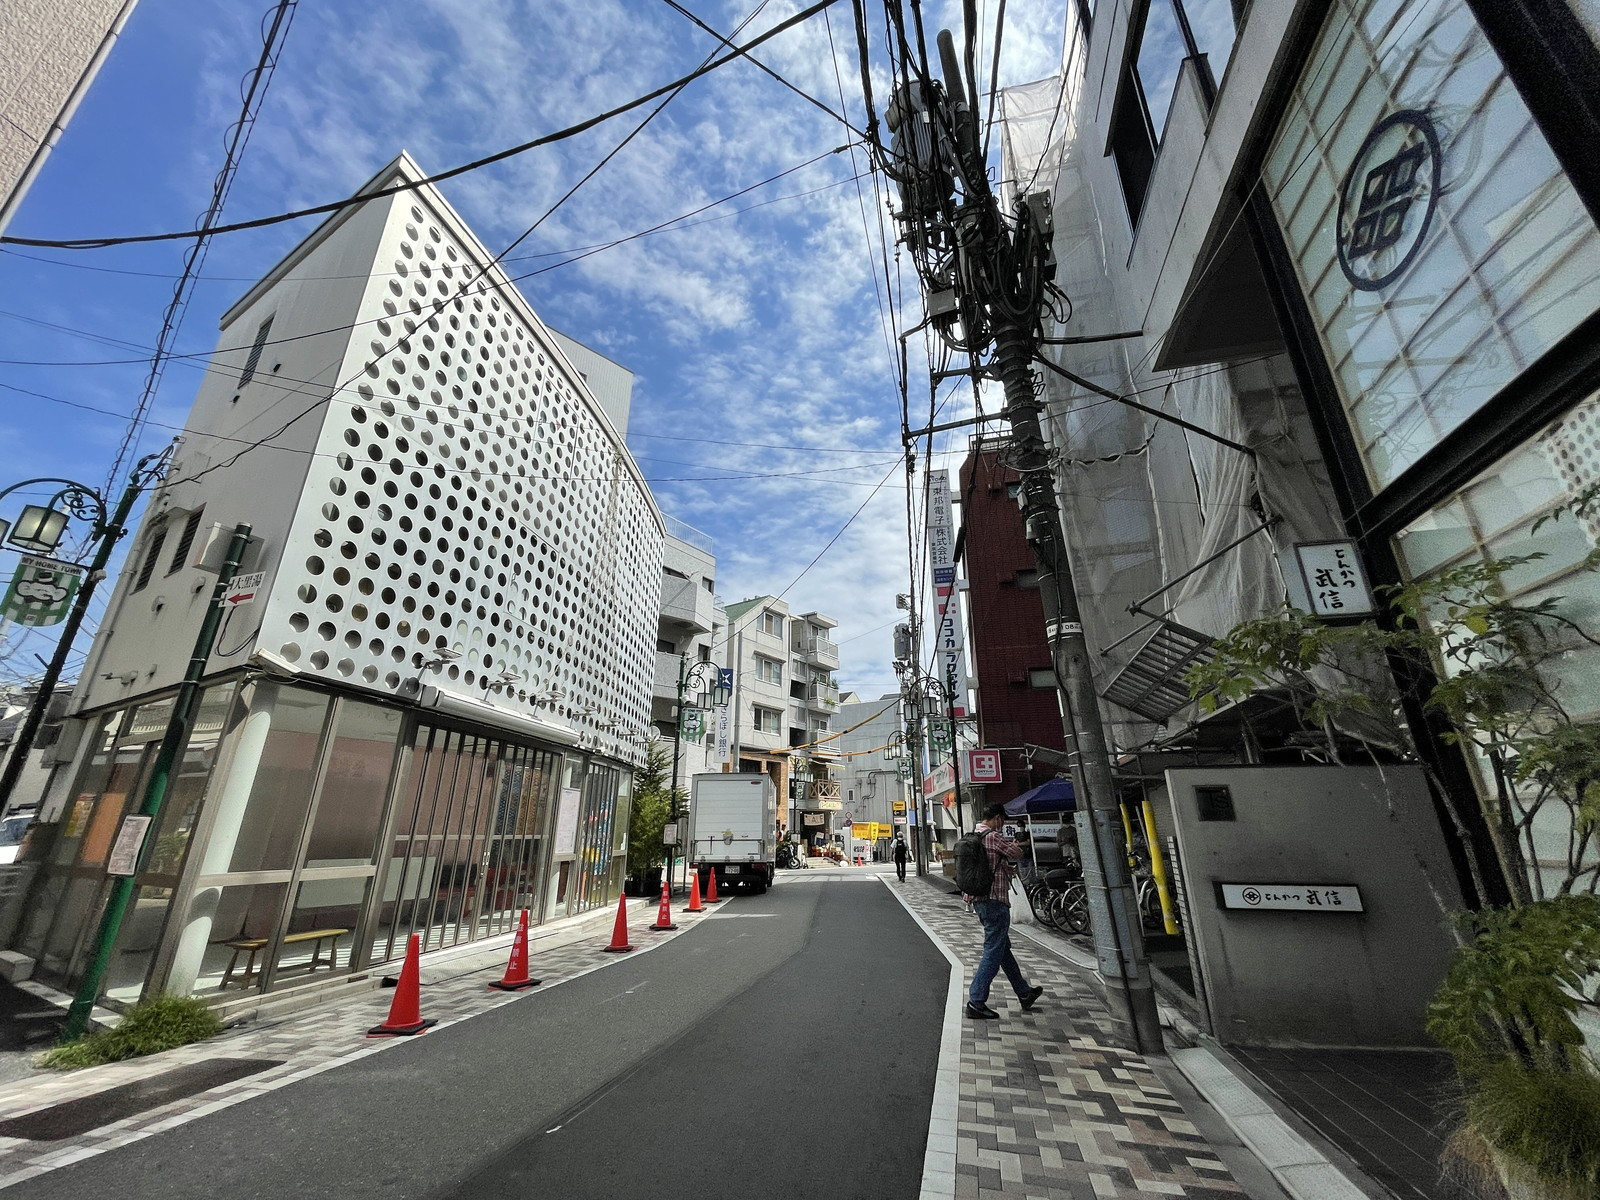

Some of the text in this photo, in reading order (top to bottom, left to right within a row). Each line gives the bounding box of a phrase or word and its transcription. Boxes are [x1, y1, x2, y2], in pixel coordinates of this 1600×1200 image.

[21, 556, 82, 575] MY HOME TOWN
[1334, 549, 1356, 588] とんかつ
[1314, 568, 1344, 609] 武信
[1265, 889, 1342, 906] とんかつ 武信
